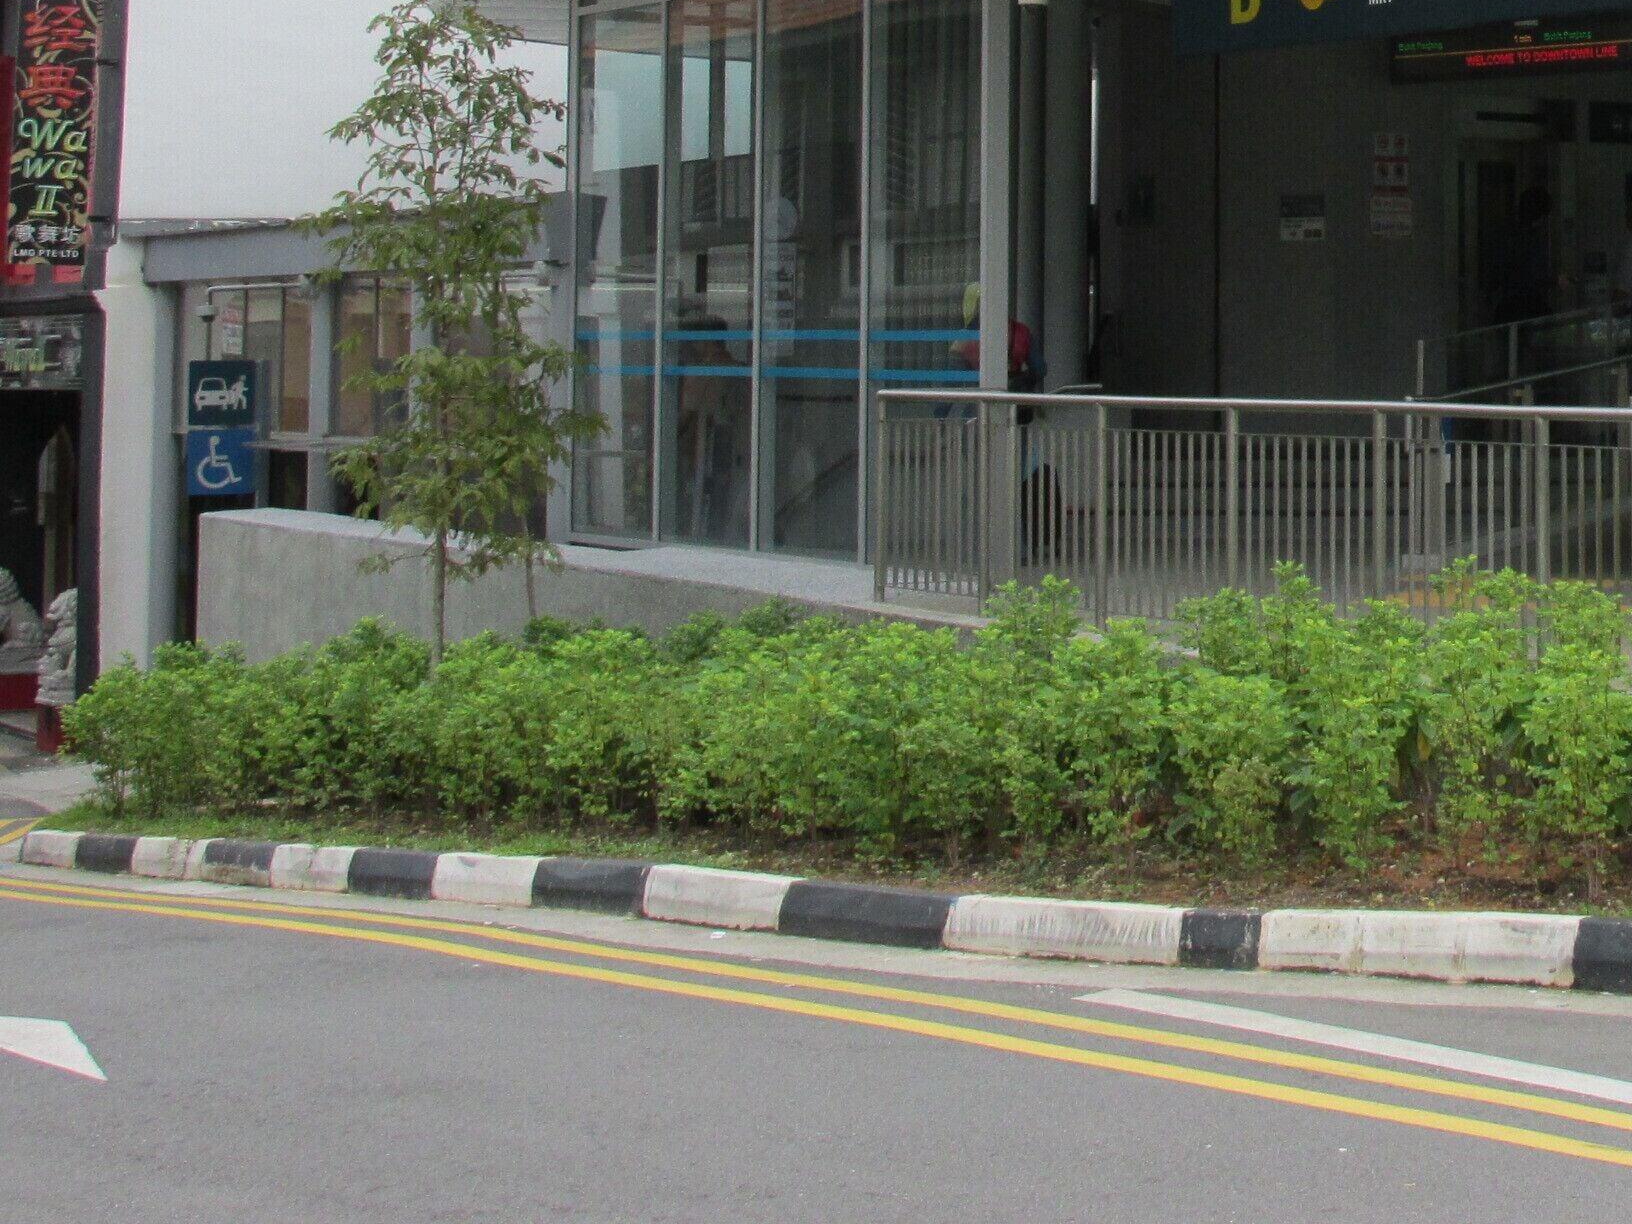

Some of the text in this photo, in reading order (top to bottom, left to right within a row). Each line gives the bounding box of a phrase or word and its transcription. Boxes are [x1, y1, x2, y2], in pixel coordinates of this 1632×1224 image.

[1465, 45, 1618, 67] WELCOME TO DOWNTOWN LINE
[18, 118, 88, 152] Wa
[38, 249, 58, 258] PTE
[61, 249, 79, 258] LTD
